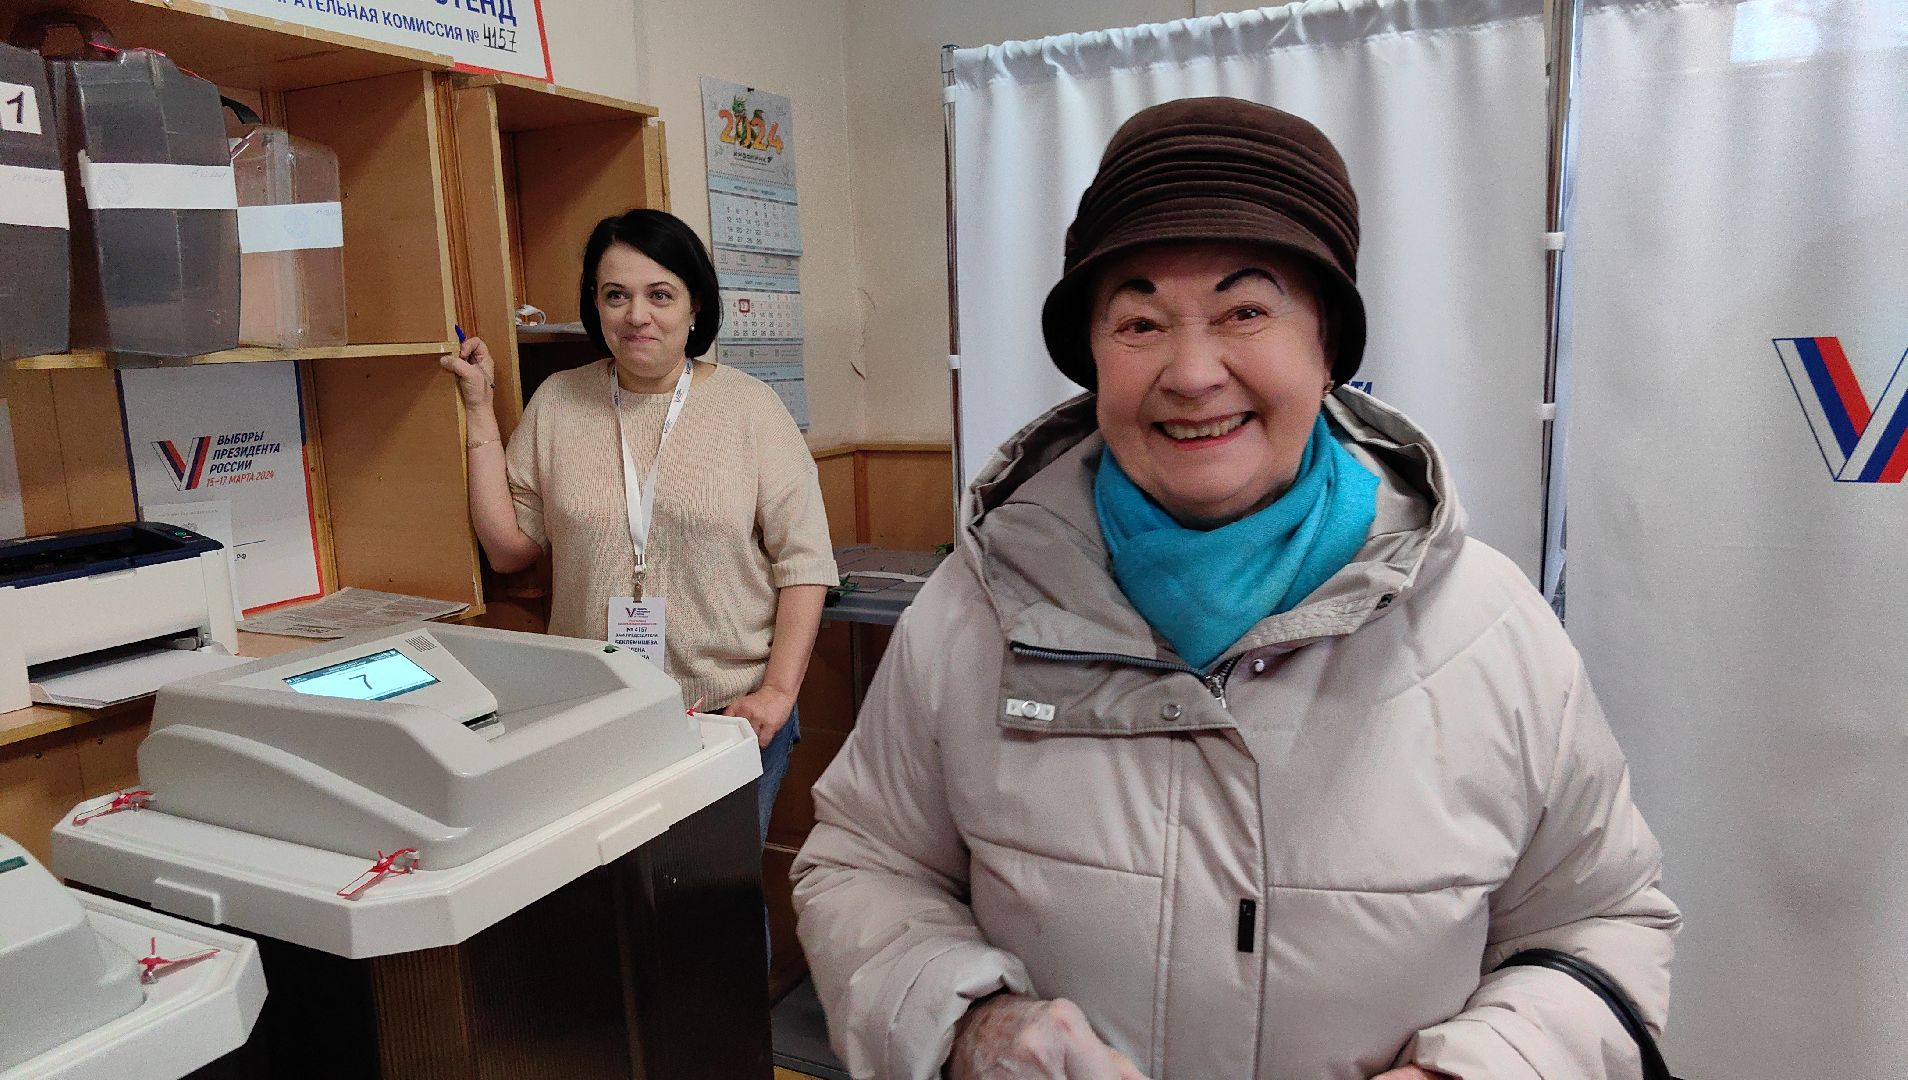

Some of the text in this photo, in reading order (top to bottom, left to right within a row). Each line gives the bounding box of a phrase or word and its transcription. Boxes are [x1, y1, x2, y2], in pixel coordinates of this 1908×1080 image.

[382, 10, 463, 42] КОМИССИЯ
[483, 23, 517, 53] 4157
[7, 91, 24, 124] 1
[719, 107, 784, 155] 2024
[217, 431, 265, 446] ВЫБОРЫ
[212, 443, 281, 460] ПРЕЗИДЕНТА
[209, 460, 253, 475] РОССИИ
[229, 473, 255, 484] МАРТА
[255, 470, 275, 481] 2024
